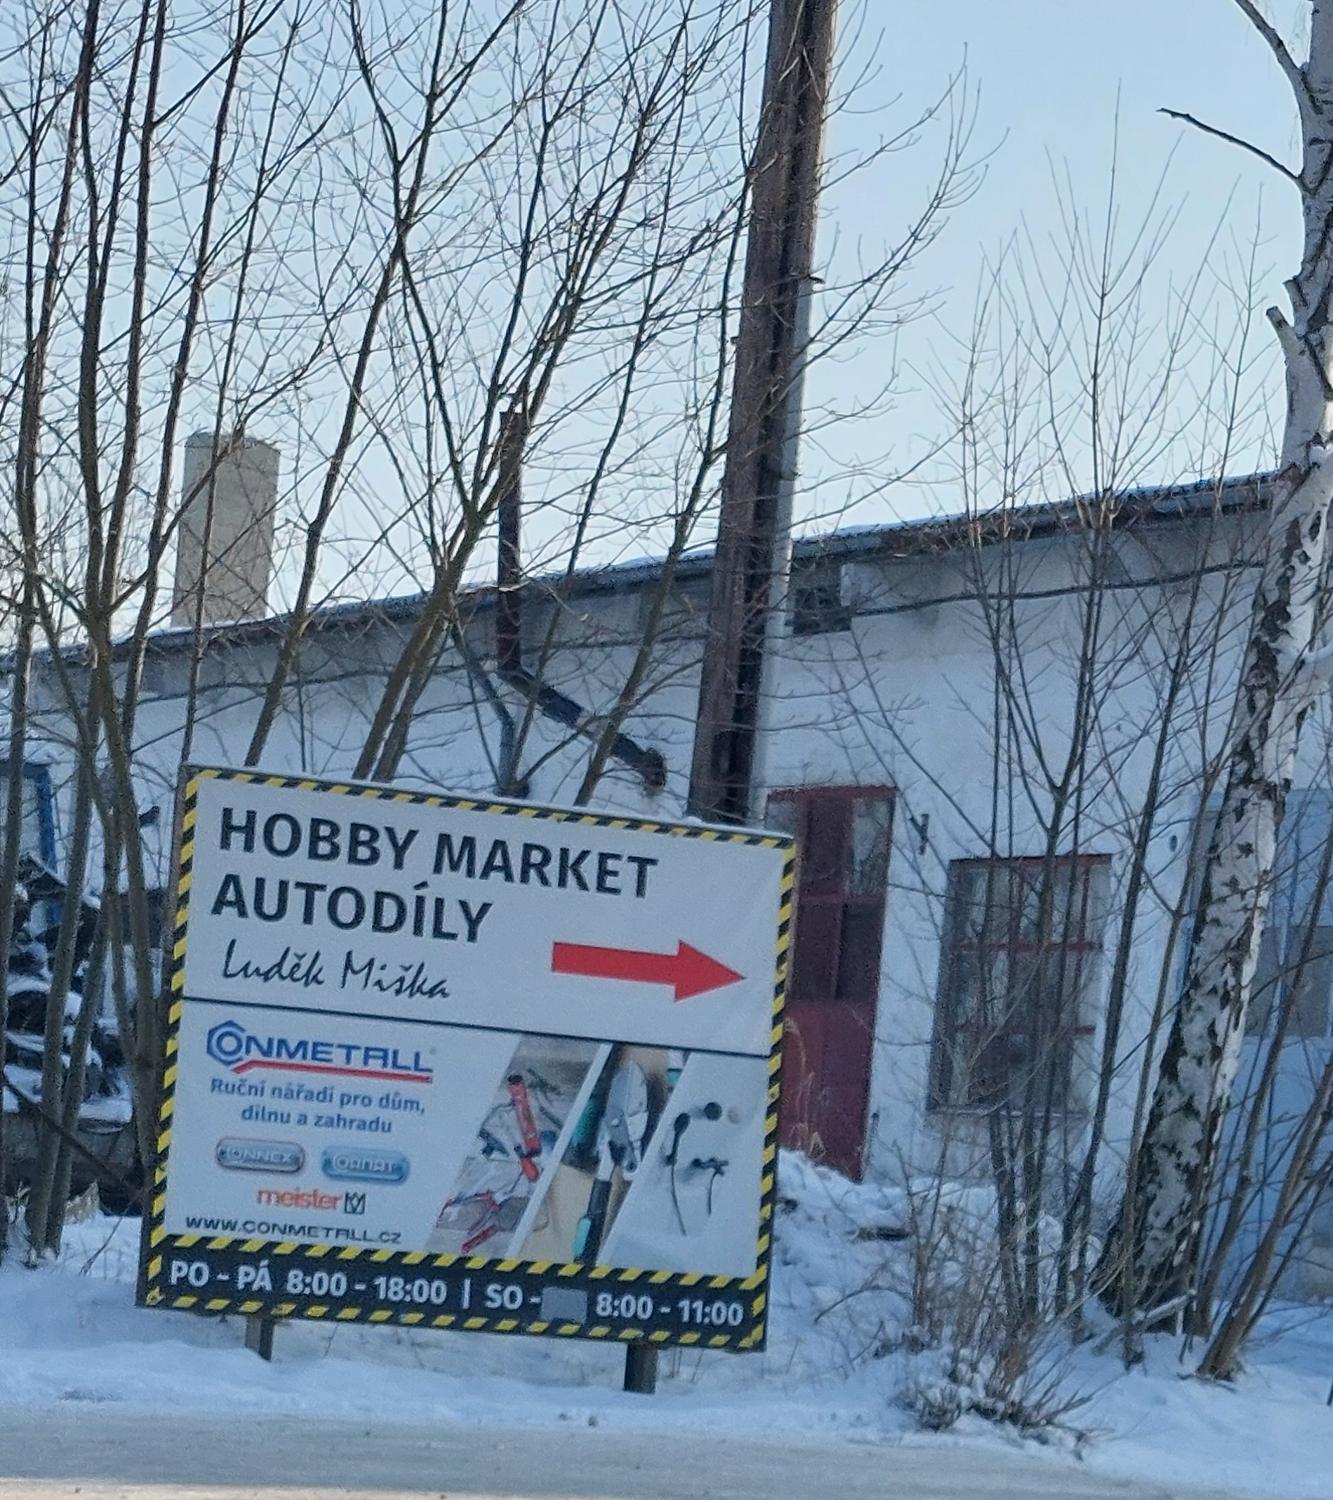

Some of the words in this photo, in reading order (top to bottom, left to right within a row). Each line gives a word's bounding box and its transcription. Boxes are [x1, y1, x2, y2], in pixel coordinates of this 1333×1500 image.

[218, 806, 419, 872] HOBBY
[432, 833, 659, 899] MARKET
[210, 872, 494, 943] AUTODÍLY
[222, 938, 325, 987] Luděk
[340, 949, 450, 999] Miška
[210, 1077, 266, 1099] Ruční
[271, 1081, 335, 1105] nářadí
[339, 1092, 373, 1109] pro
[378, 1090, 426, 1115] dům,
[240, 1104, 292, 1125] dílnu
[296, 1113, 308, 1126] a
[313, 1113, 393, 1134] zahradu
[256, 1186, 342, 1210] meister
[169, 1259, 210, 1288] PO
[215, 1273, 230, 1282] -
[236, 1259, 273, 1293] PÁ
[285, 1268, 348, 1298] 8:00
[354, 1281, 367, 1291] -
[373, 1275, 448, 1305] 18:00
[484, 1283, 523, 1310] SO
[595, 1293, 653, 1320] 8:00
[658, 1306, 671, 1314] -
[677, 1299, 744, 1327] 11:00
